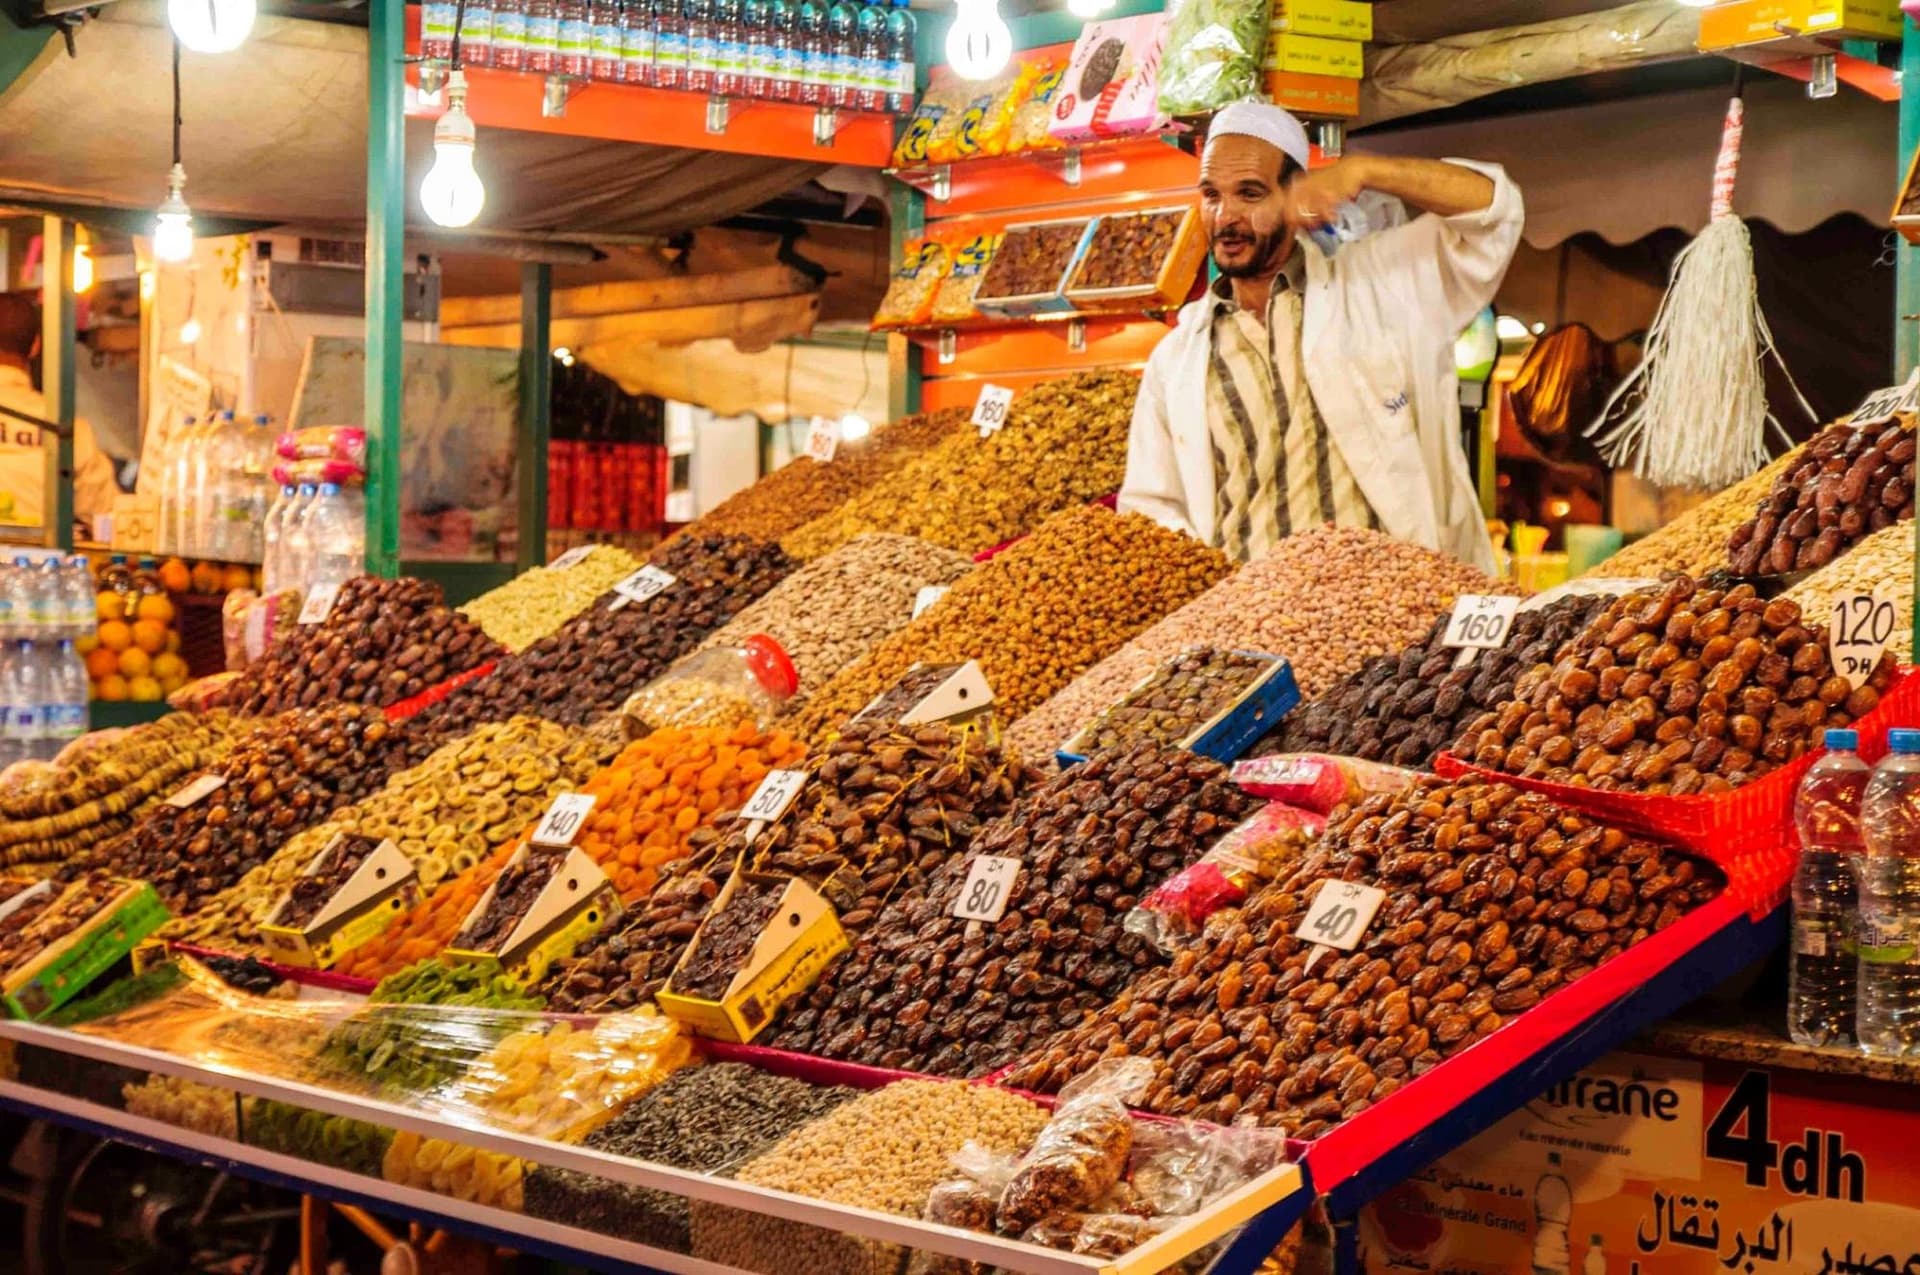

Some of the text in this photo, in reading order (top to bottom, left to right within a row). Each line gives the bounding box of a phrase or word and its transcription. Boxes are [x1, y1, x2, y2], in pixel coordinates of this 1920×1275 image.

[1458, 613, 1504, 642] 160
[1834, 596, 1895, 648] 120
[1841, 656, 1872, 675] DH
[751, 786, 785, 815] 50
[543, 809, 579, 838] 140
[966, 878, 1001, 914] 80
[1313, 903, 1358, 941] 40
[1484, 1212, 1527, 1233] Grand
[1637, 1190, 1793, 1273] البرتقال
